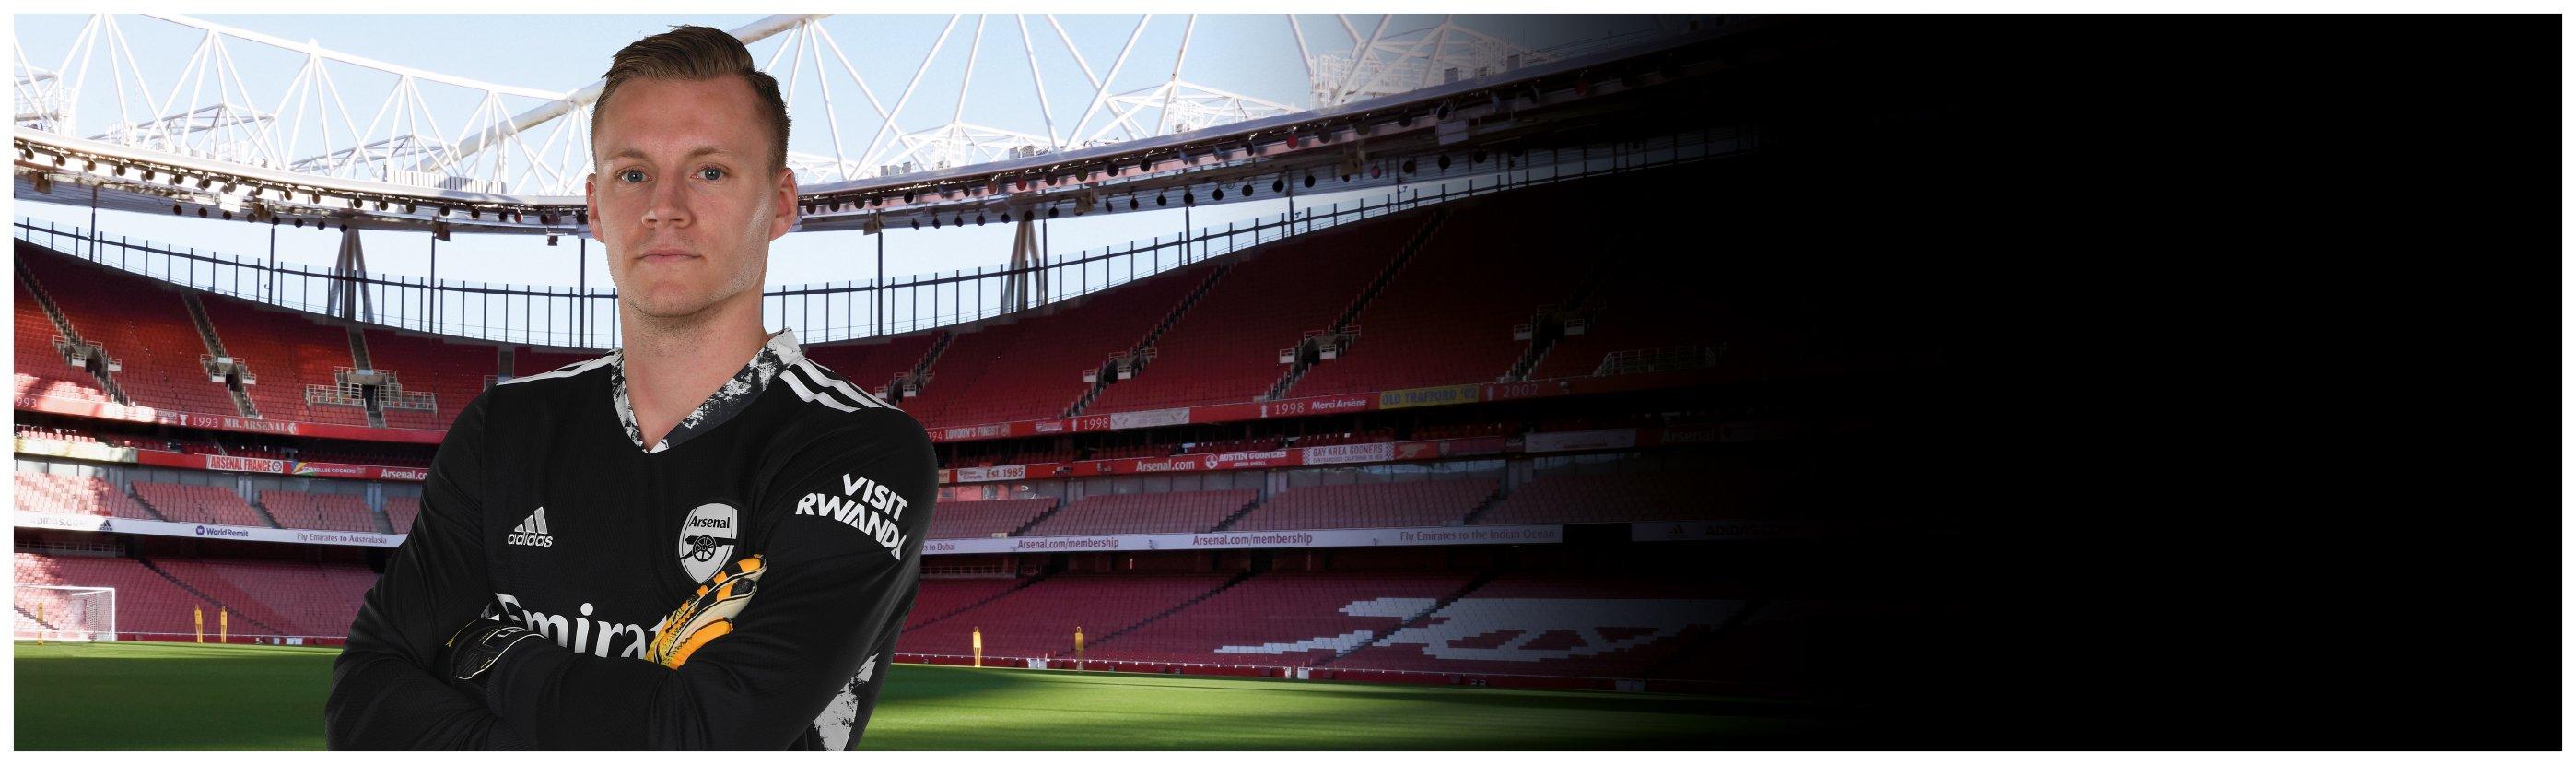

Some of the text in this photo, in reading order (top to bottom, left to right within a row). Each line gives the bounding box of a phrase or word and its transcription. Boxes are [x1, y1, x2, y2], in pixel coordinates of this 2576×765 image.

[1503, 385, 1539, 397] 2002
[1275, 402, 1305, 415] 1998
[1312, 398, 1367, 410] Merci Arsène
[192, 416, 219, 428] 1993
[1083, 418, 1109, 430] 1998
[1219, 451, 1287, 462] AUSTIN GOONERS
[1313, 447, 1326, 457] BAY
[1329, 447, 1347, 456] AREA
[211, 455, 271, 472] ARSENAL FRANCE
[1136, 459, 1195, 472] Arsenal.com
[843, 473, 908, 522] VISIT
[688, 515, 731, 529] Arsenal
[206, 527, 249, 538] WorldRemit
[298, 532, 387, 545] Fly Emirates to Australasia
[1400, 529, 1555, 543] Fly Emirates to the Indian Ocean
[508, 532, 553, 547] adidas
[1017, 536, 1119, 550] Arsenal.com/membership
[1193, 532, 1313, 547] Arsenal.com/membership
